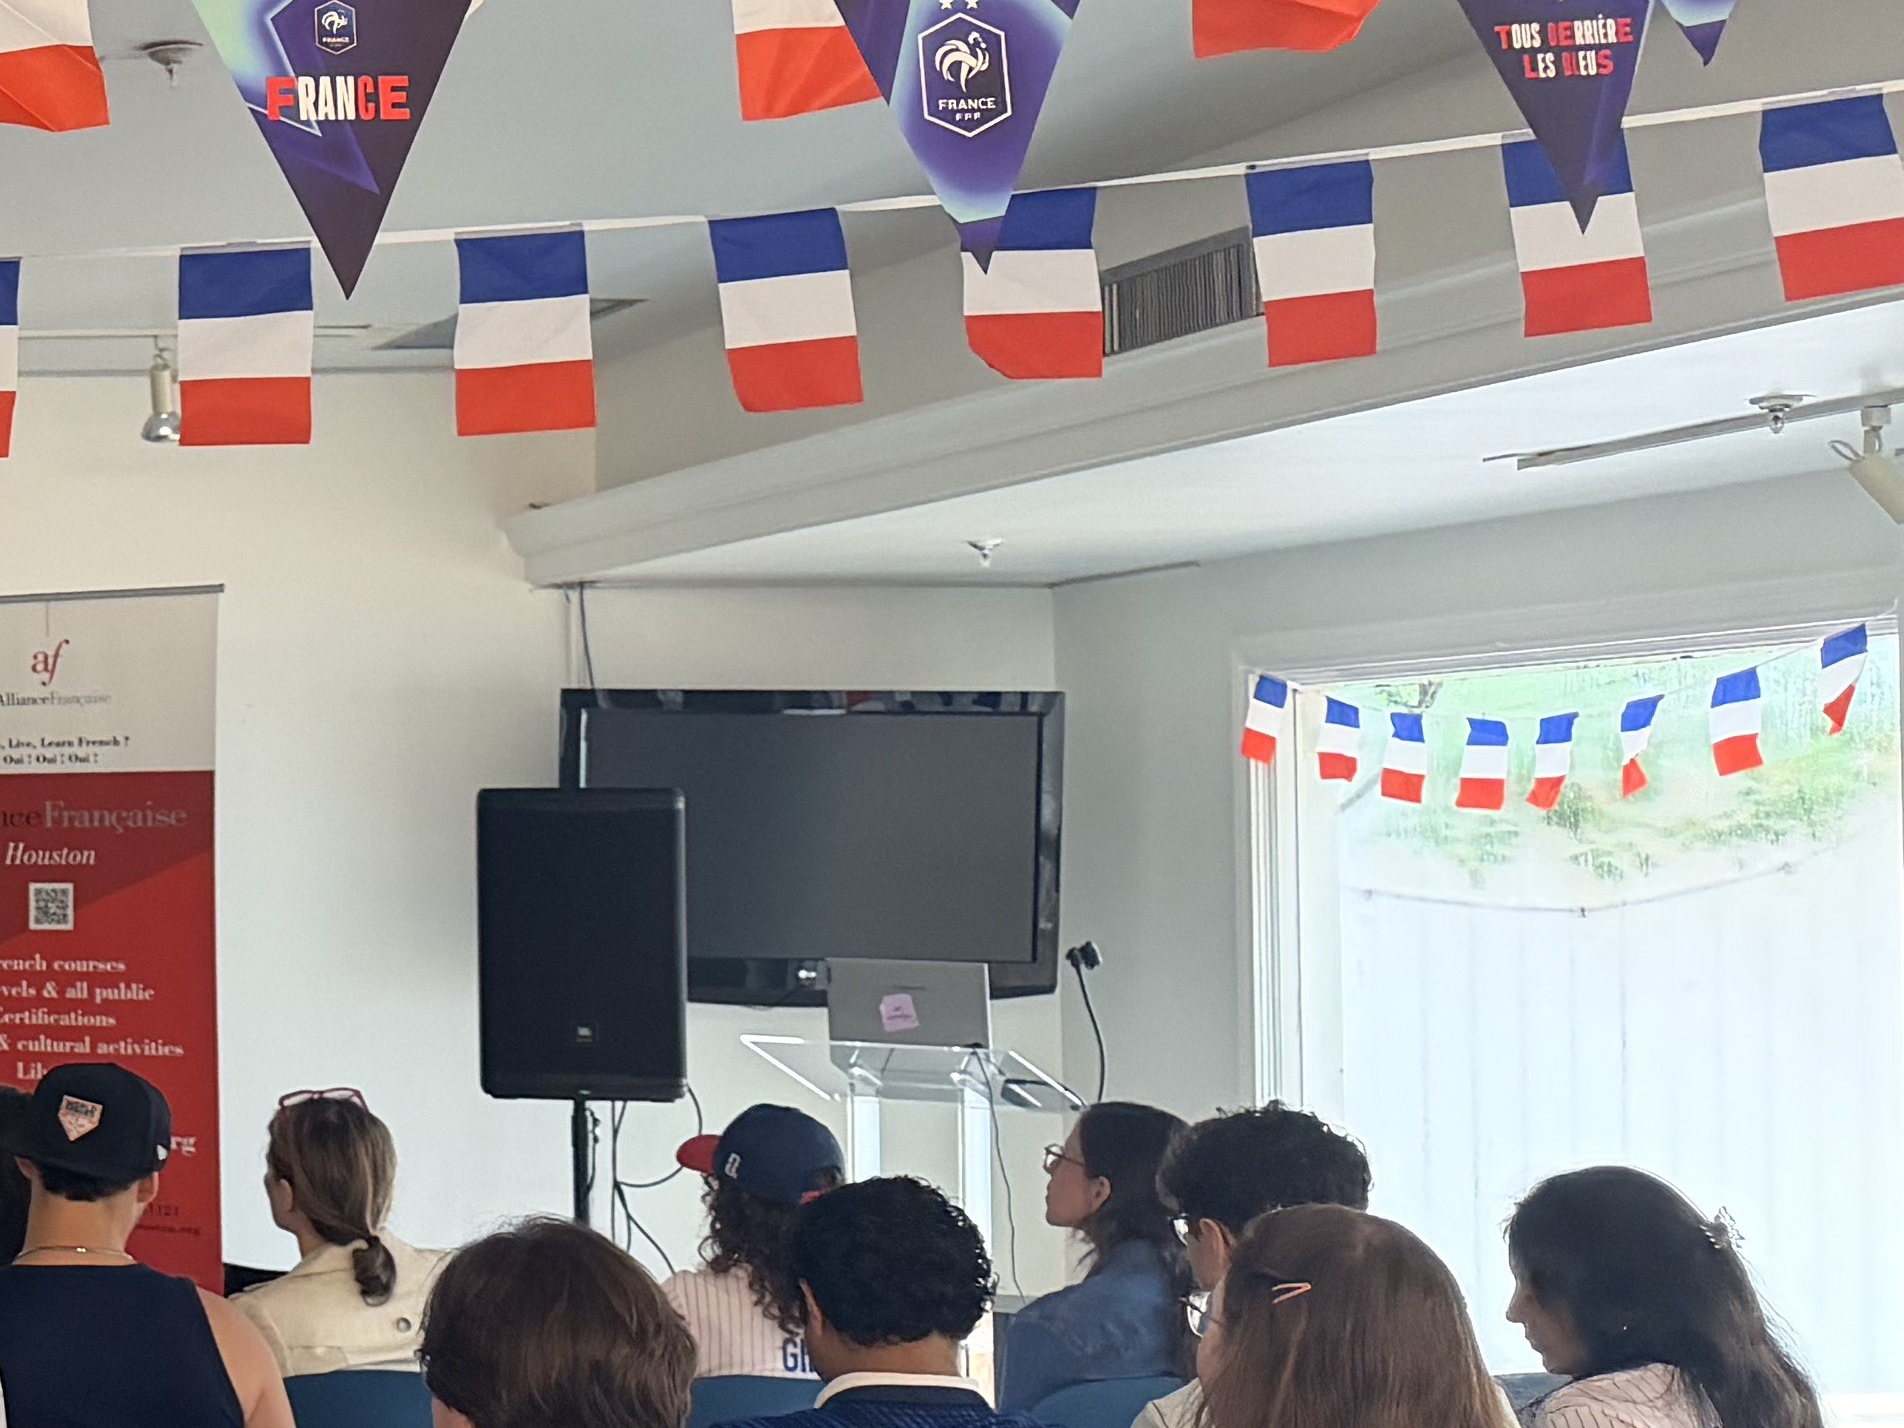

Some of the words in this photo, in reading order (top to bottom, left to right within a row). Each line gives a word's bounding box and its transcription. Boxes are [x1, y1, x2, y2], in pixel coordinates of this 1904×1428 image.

[1494, 22, 1542, 50] TOUS
[1522, 52, 1557, 80] LES
[265, 75, 411, 122] FRANCE
[938, 98, 996, 110] FRANCE
[40, 736, 75, 749] Learn
[78, 735, 120, 747] French
[5, 841, 97, 866] Houston
[53, 955, 126, 972] courses
[42, 982, 59, 999] &
[65, 981, 88, 999] all
[95, 982, 155, 1004] public
[17, 1034, 91, 1054] cultural
[97, 1038, 184, 1057] activities
